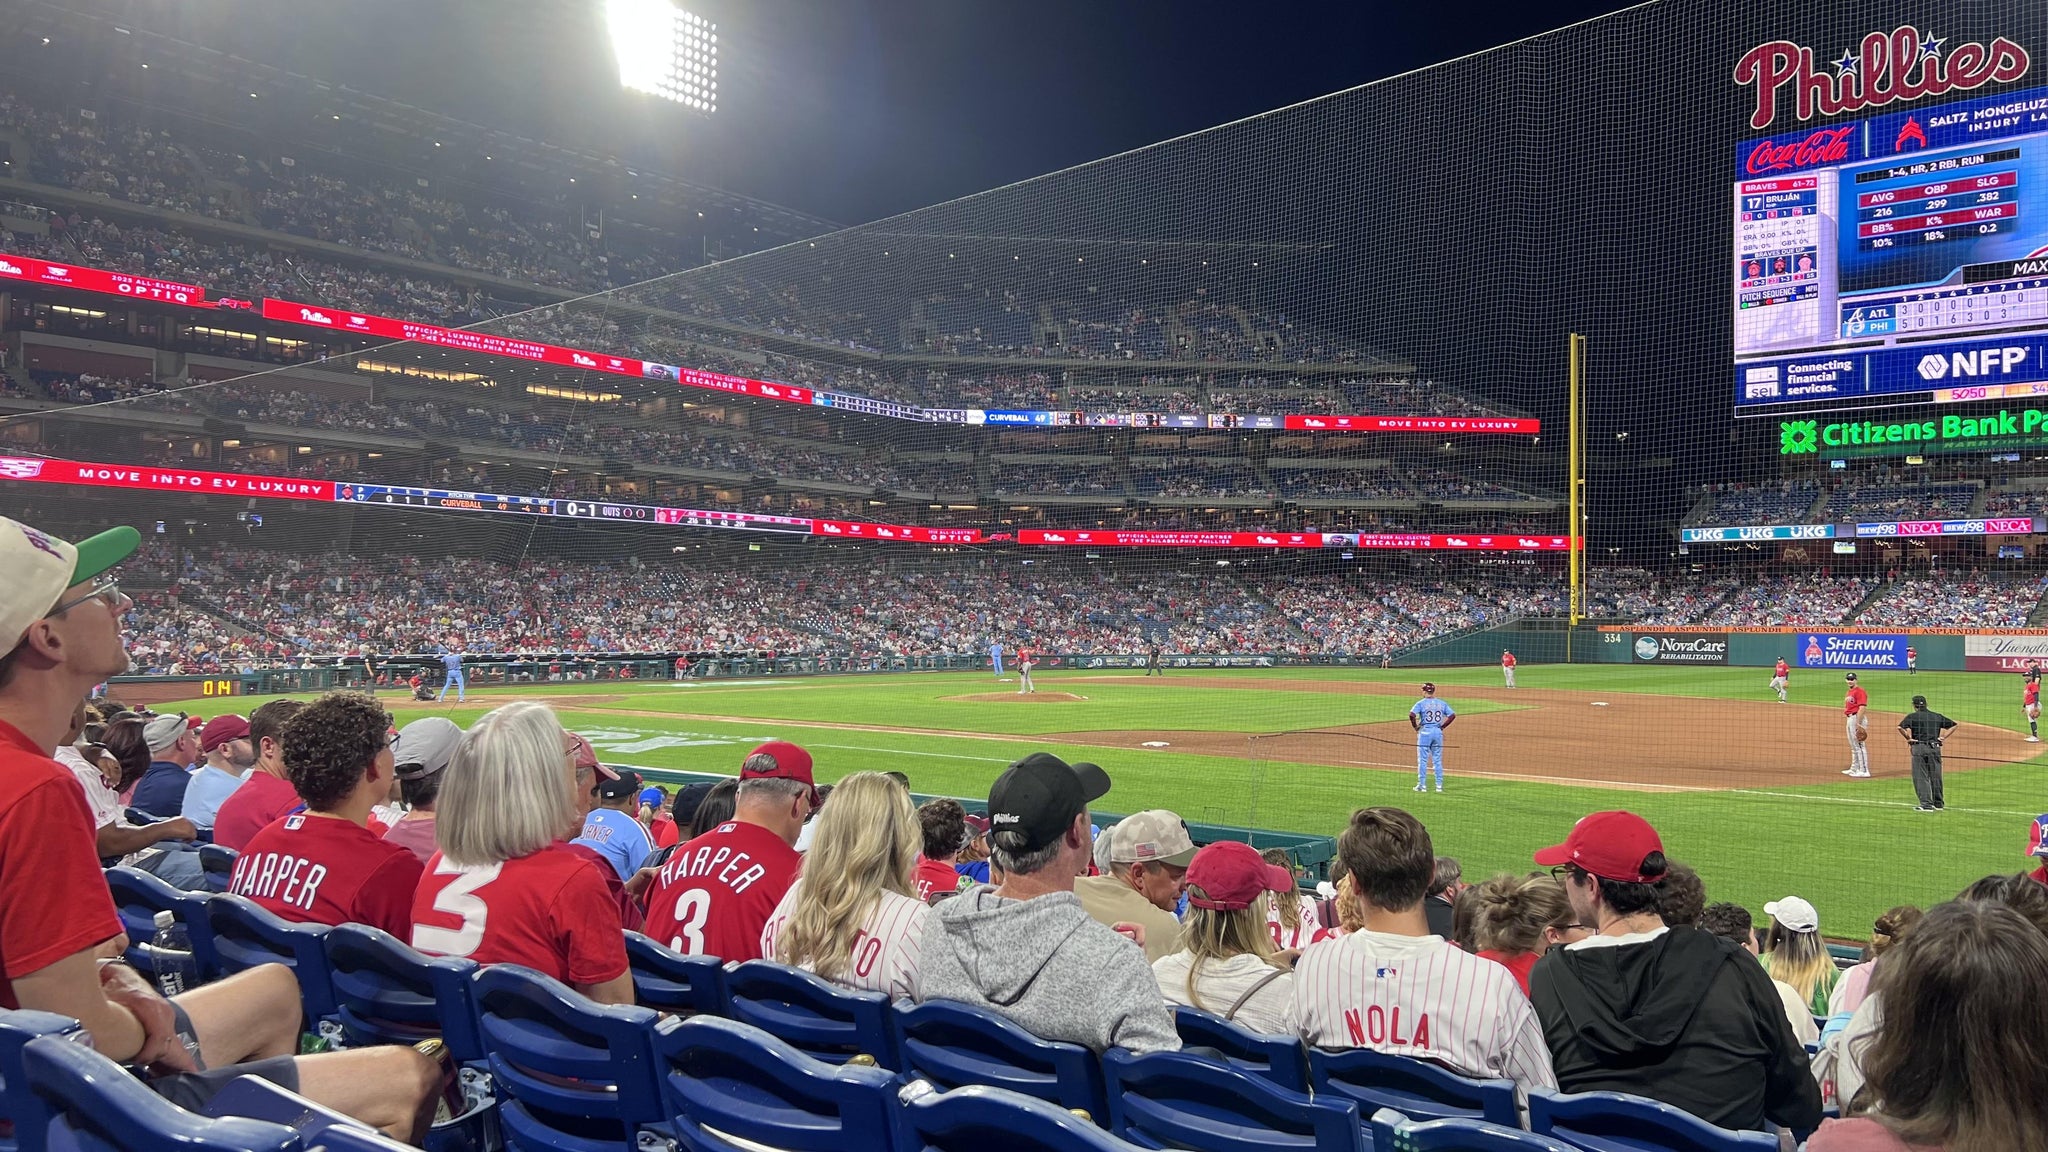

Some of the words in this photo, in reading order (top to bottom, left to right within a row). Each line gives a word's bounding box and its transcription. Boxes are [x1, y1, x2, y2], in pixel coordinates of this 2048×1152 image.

[1733, 25, 2030, 129] Phillies
[1930, 112, 1968, 128] SALTZ
[1968, 116, 2020, 132] INJURY
[1746, 126, 1855, 174] Coca-Cola
[1888, 168, 1908, 178] 1-4,
[1910, 166, 1928, 176] HR,
[1930, 163, 1936, 171] 2
[1939, 160, 1959, 171] RBI,
[1962, 156, 1984, 166] RUN
[1745, 183, 1778, 192] BRAVES
[1870, 193, 1894, 204] AVG
[1924, 184, 1948, 194] OBP
[1977, 176, 1999, 187] SLG
[1747, 198, 1762, 209] 17
[1766, 193, 1800, 202] BRUJÁN
[1873, 208, 1892, 217] .216
[1926, 199, 1948, 210] .299
[1976, 192, 1999, 202] .382
[1872, 224, 1894, 234] BB%
[1926, 216, 1942, 226] K%
[1974, 208, 2002, 219] WAR
[1872, 238, 1893, 248] 10%
[1924, 230, 1944, 241] 18%
[1979, 224, 1997, 234] 0.2
[1754, 250, 1780, 258] BRAVES
[2013, 260, 2048, 276] MAX
[41, 274, 72, 282] CADILLAC
[118, 284, 188, 302] OPTIQ
[136, 279, 195, 294] ALL-ELECTRIC
[1742, 293, 1761, 302] PITCH
[1762, 286, 1796, 299] SEQUENCE
[1869, 309, 1889, 319] ATL
[1902, 305, 1907, 314] 3
[1918, 304, 1923, 313] 0
[1934, 302, 1940, 311] 0
[1951, 300, 1956, 309] 0
[1968, 298, 1972, 308] 0
[1985, 296, 1988, 306] 1
[2001, 295, 2006, 304] 0
[2018, 293, 2023, 302] 0
[300, 308, 332, 324] Phillies
[1870, 322, 1888, 331] PHI
[1902, 319, 1907, 328] 5
[1918, 317, 1923, 327] 0
[1936, 316, 1939, 325] 1
[1951, 314, 1956, 324] 6
[1968, 312, 1972, 322] 3
[1984, 311, 1989, 320] 0
[2002, 309, 2006, 318] 3
[403, 324, 444, 336] OFFICIAL
[448, 332, 480, 342] LUXURY
[483, 337, 505, 347] AUTO
[509, 342, 545, 353] PARTNER
[441, 337, 502, 351] PHILADELPHIA
[506, 347, 543, 358] PHILLIES
[572, 353, 596, 366] Phillies
[1788, 360, 1852, 373] Connecting
[1952, 346, 2027, 378] NFP
[686, 376, 734, 390] ESCALADE
[1787, 371, 1837, 384] financial
[761, 385, 780, 396] Phillies
[1787, 384, 1837, 395] services.
[989, 413, 1029, 422] CURVEBALL
[1823, 421, 1937, 446] Citizens
[1942, 410, 2018, 438] Bank
[1944, 440, 1999, 448] HARRY
[79, 468, 139, 481] MOVE
[152, 474, 201, 486] INTO
[213, 478, 237, 488] EV
[248, 481, 322, 495] LUXURY
[440, 499, 482, 508] CURVEBALL
[567, 502, 596, 516] 0-1
[602, 507, 620, 517] OUTS
[823, 523, 841, 533] Phillies
[877, 527, 893, 536] Phillies
[1691, 530, 1724, 540] UKG
[1740, 528, 1774, 539] UKG
[1790, 526, 1826, 538] UKG
[1881, 524, 1896, 534] 98
[1902, 522, 1940, 533] NECA
[1968, 522, 1984, 532] 98
[1989, 520, 2030, 531] NECA
[1044, 533, 1065, 541] Phillies
[1257, 536, 1278, 544] Phillies
[1447, 538, 1468, 546] Phillies
[1519, 539, 1540, 547] Phillies
[1604, 634, 1621, 643] 334
[1660, 638, 1725, 652] NovaCare
[1826, 636, 1894, 651] SHERWIN
[218, 681, 230, 695] 14
[1425, 710, 1442, 723] 38
[660, 846, 766, 894] HARPER
[230, 852, 326, 910] HARPER
[412, 854, 504, 958] 3
[670, 888, 711, 957] 3
[160, 972, 177, 999] art
[1345, 1005, 1429, 1050] NOLA
